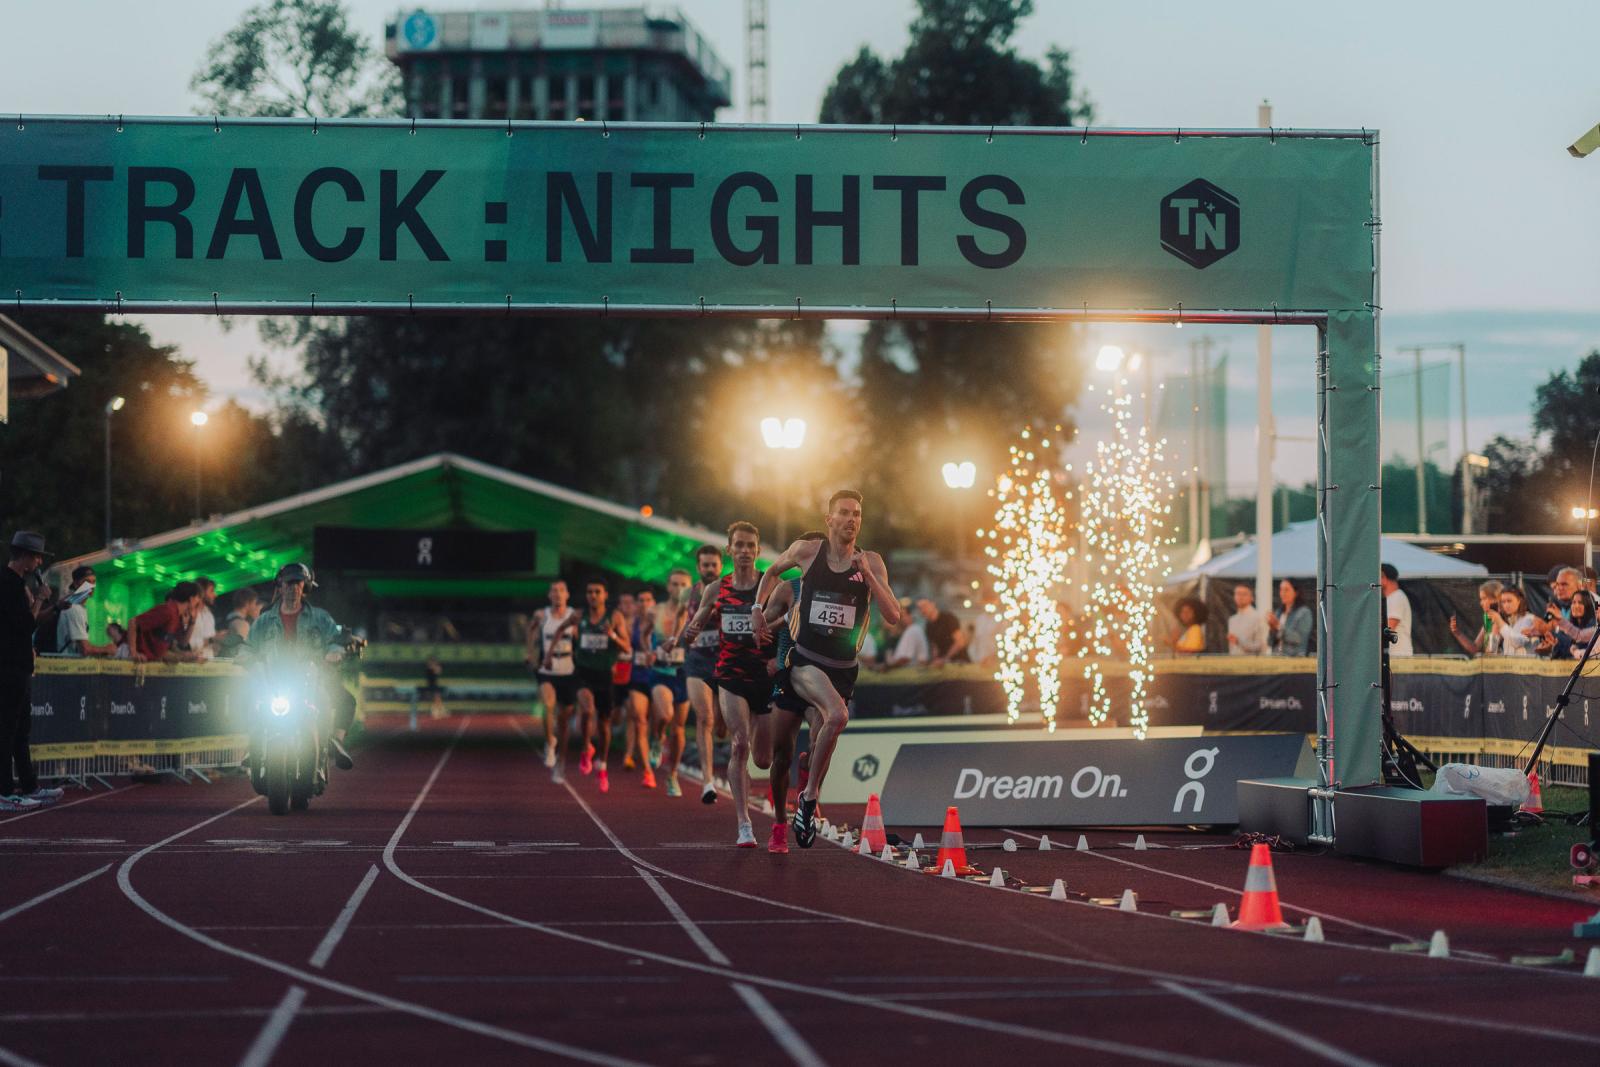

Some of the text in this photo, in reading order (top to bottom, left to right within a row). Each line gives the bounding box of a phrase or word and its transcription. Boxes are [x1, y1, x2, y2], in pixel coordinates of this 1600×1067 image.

[0, 164, 1026, 269] TRACK:NIGHTS
[728, 620, 753, 633] 131
[817, 610, 846, 626] 451
[953, 765, 1128, 800] Dream On.
